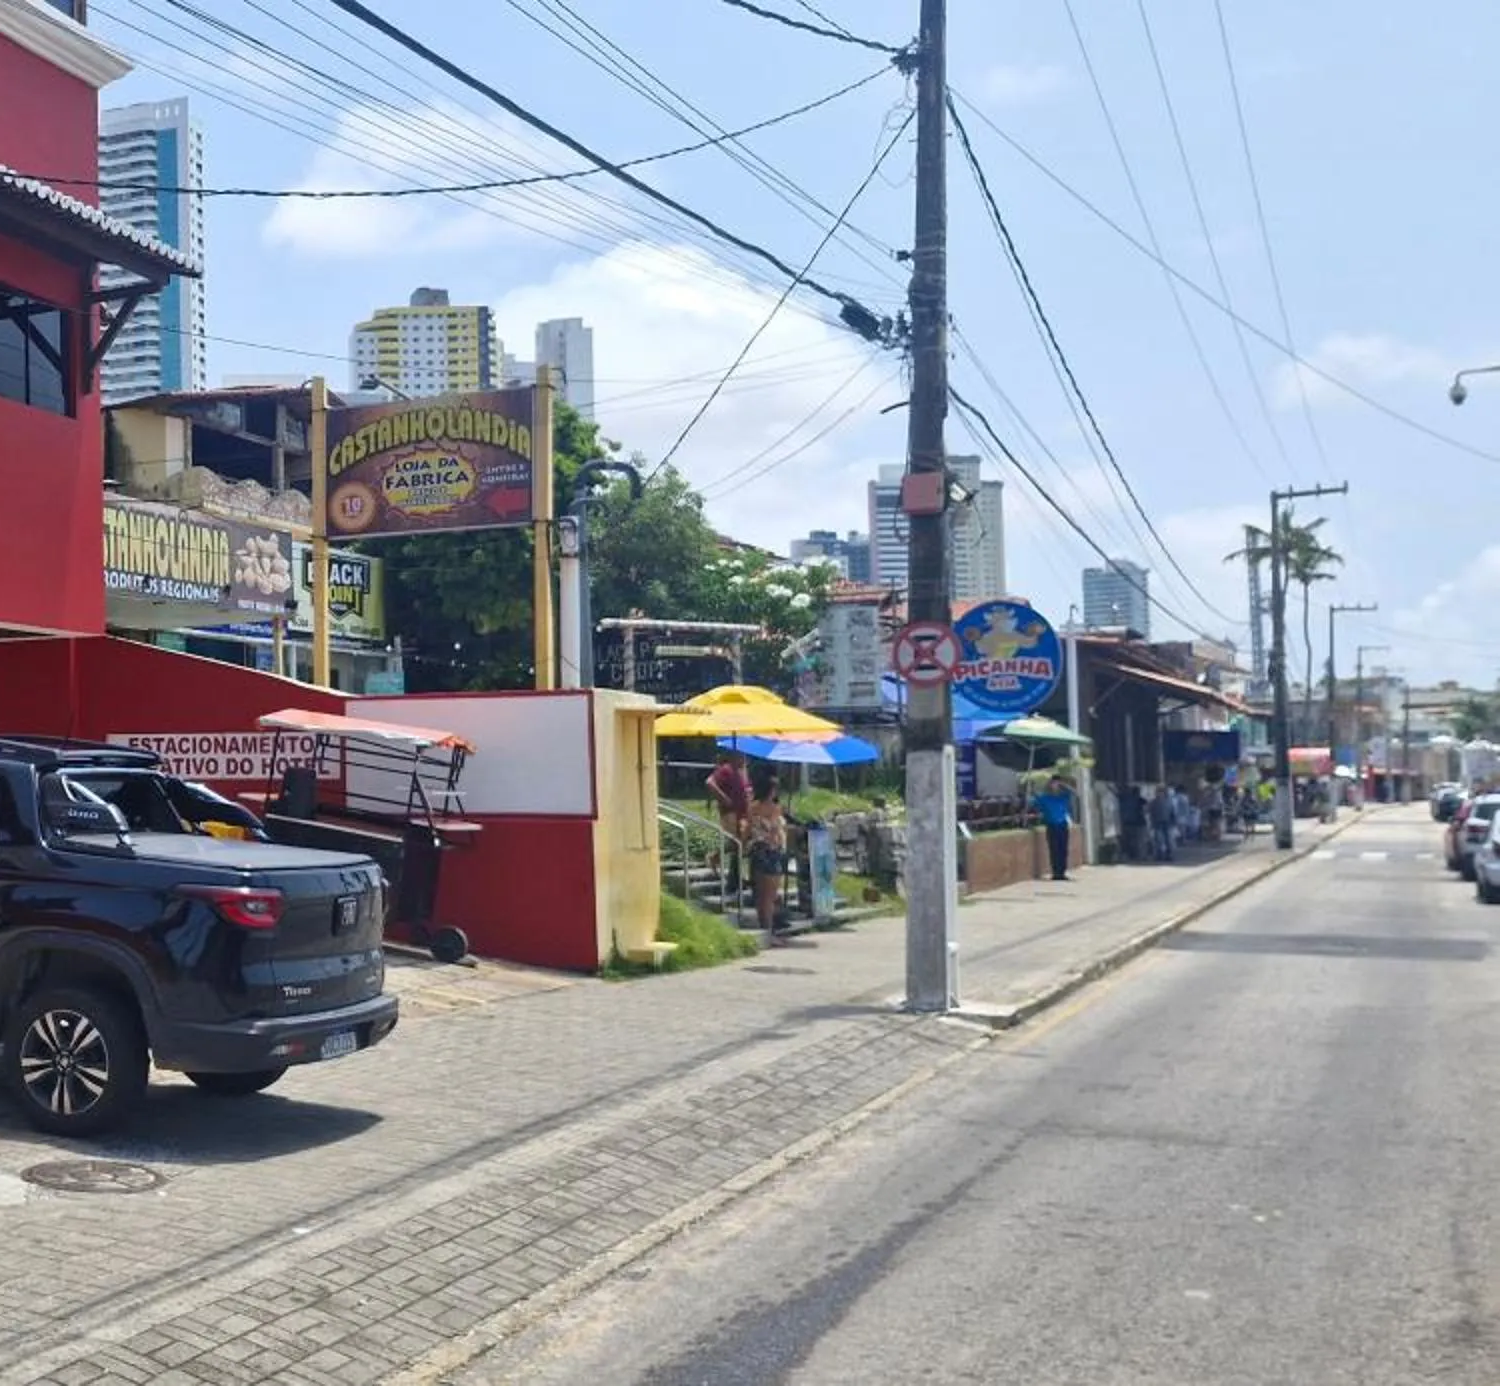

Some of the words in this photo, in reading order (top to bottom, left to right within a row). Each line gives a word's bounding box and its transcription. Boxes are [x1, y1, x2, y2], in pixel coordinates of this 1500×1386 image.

[395, 460, 431, 472] LOJA
[438, 456, 460, 468] DA
[160, 579, 219, 602] REGIONAIS
[128, 736, 314, 755] ESTACIONAMENTO
[226, 758, 254, 775] DO
